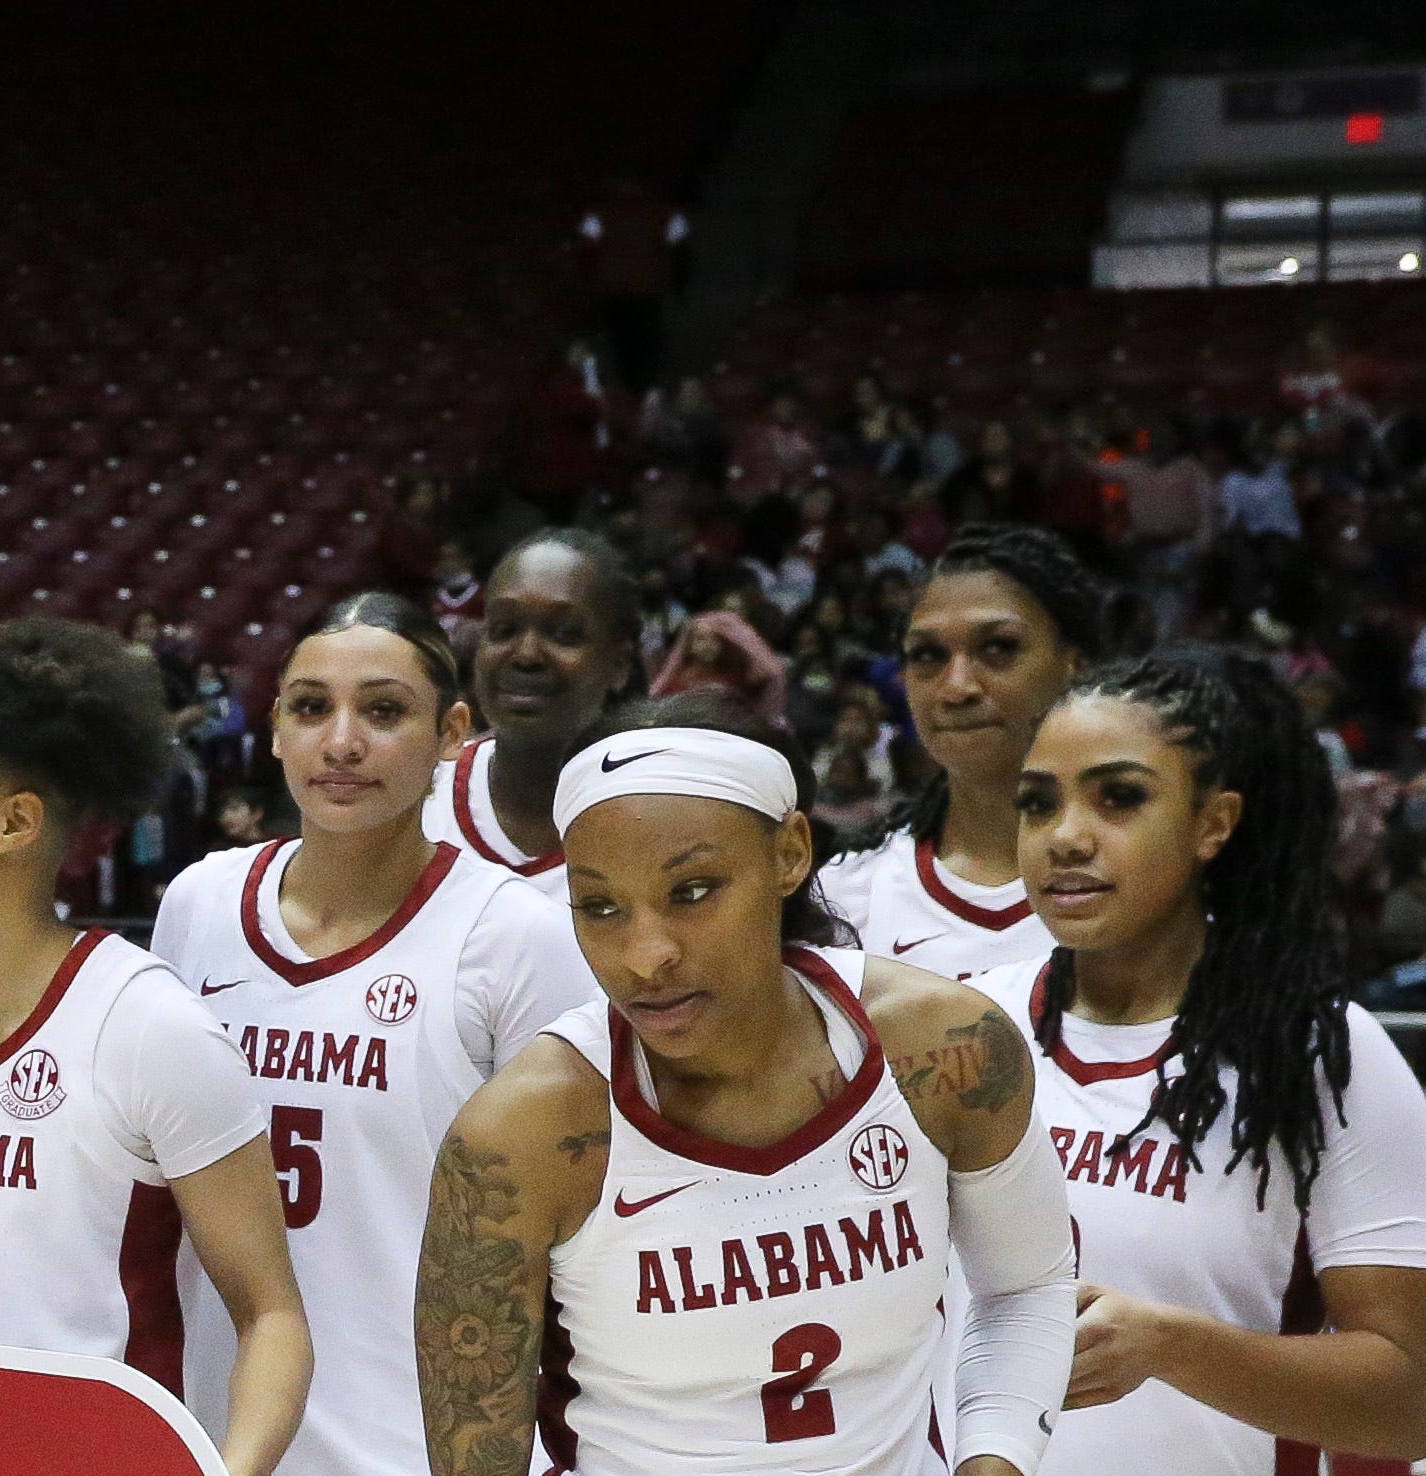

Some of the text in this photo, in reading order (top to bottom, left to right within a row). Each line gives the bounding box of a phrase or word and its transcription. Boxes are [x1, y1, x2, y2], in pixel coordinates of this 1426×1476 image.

[366, 974, 417, 1023] SEC
[11, 1049, 58, 1102] SEC
[221, 1023, 388, 1091] ABAMA
[0, 1093, 54, 1118] GRADUATE
[270, 1105, 323, 1229] 5
[849, 1124, 909, 1190] SEC
[1049, 1126, 1187, 1203] BAMA
[637, 1200, 924, 1313] ALABAMA
[761, 1322, 842, 1443] 2
